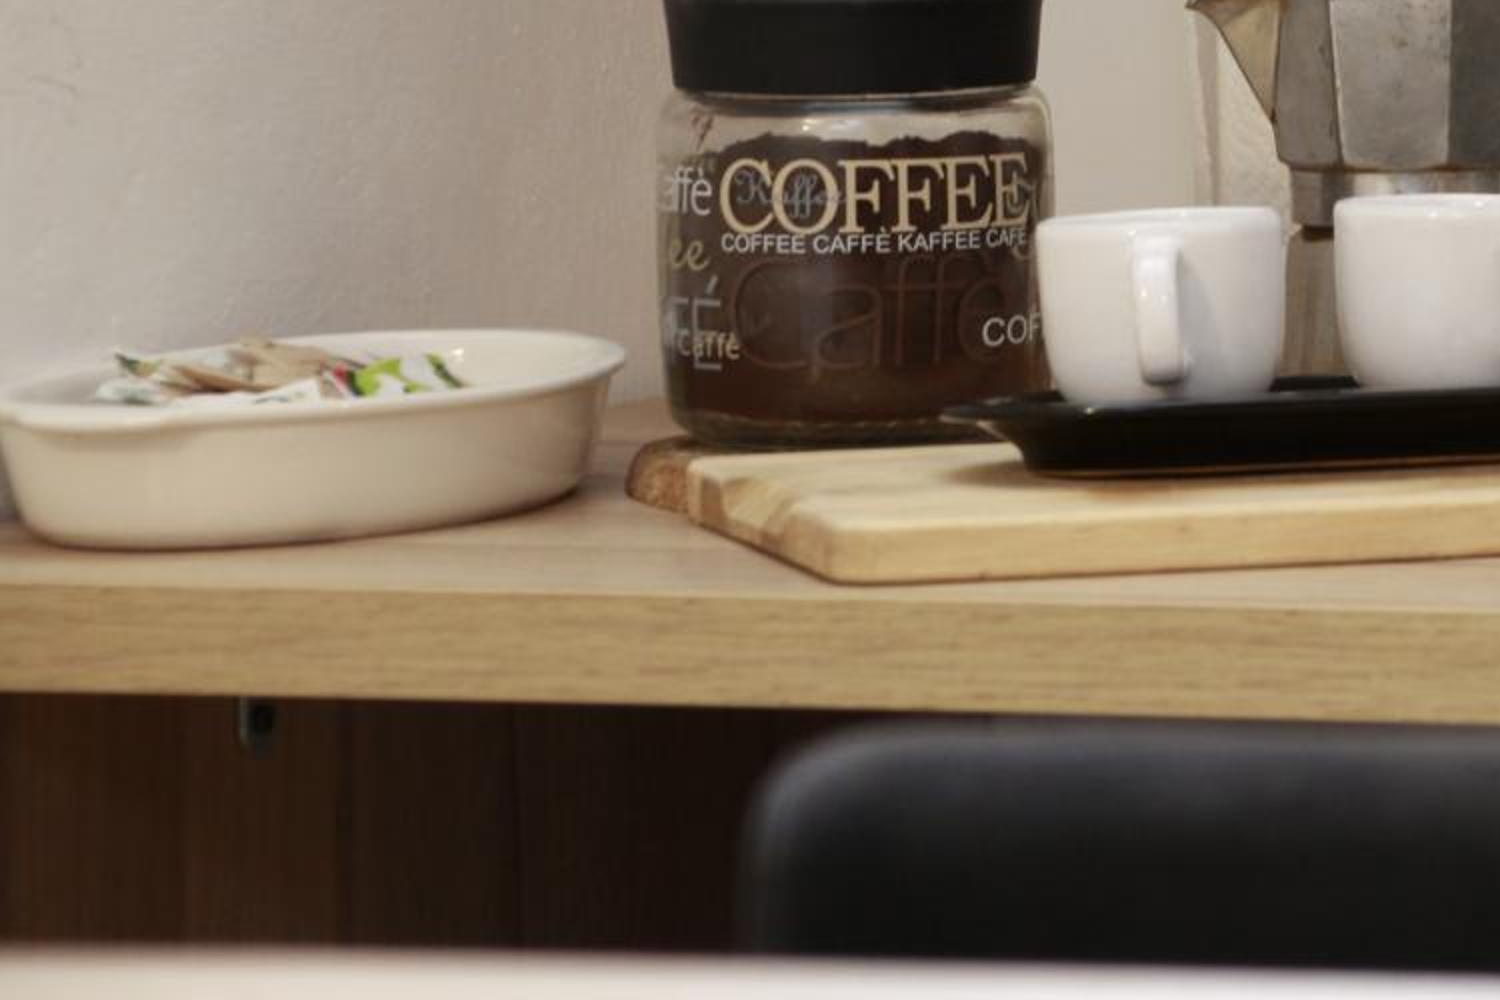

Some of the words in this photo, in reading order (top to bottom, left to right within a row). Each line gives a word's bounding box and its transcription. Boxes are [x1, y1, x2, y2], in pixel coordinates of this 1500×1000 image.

[719, 152, 1031, 235] COFFEE
[721, 233, 806, 254] COFFEE
[813, 226, 892, 254] CAFFÈ
[897, 231, 982, 252] KAFFEE
[981, 314, 1042, 347] COF
